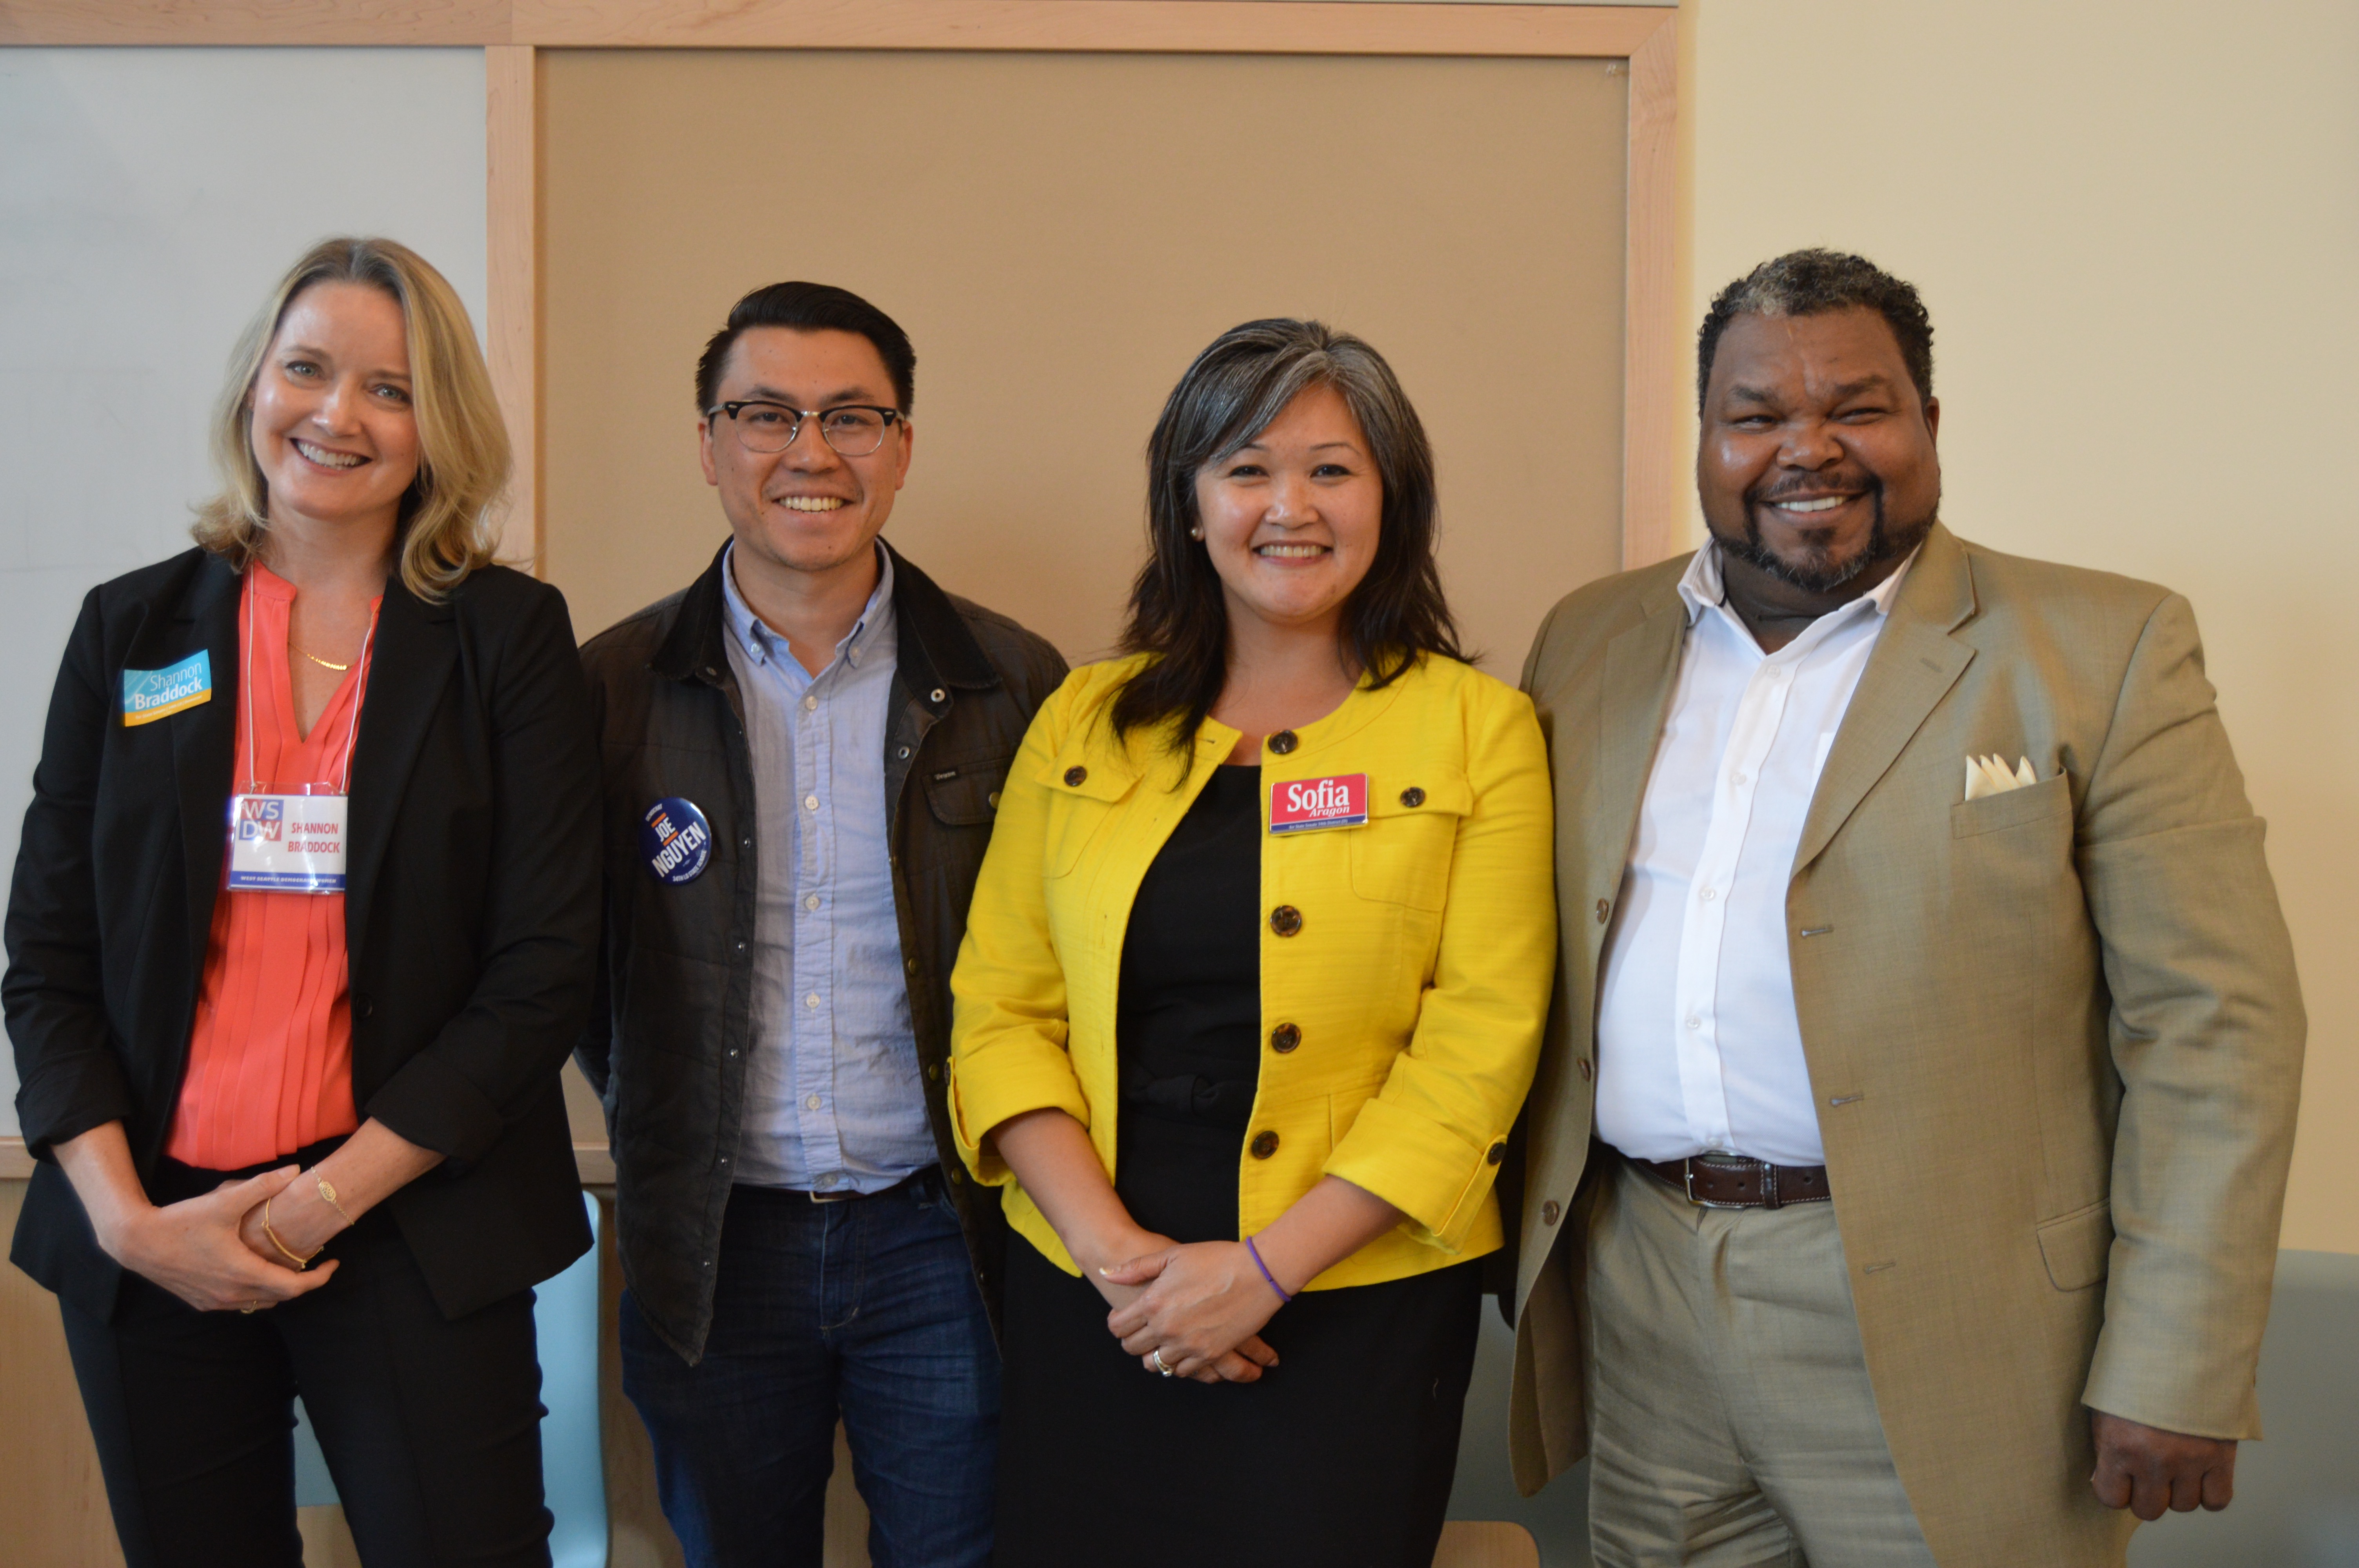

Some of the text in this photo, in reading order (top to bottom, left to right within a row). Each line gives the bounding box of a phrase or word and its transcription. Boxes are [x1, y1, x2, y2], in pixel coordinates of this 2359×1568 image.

[150, 662, 202, 691] Shannon
[135, 677, 202, 710] Braddock
[1287, 779, 1350, 812] Sofia
[242, 801, 279, 819] WS
[1309, 806, 1350, 817] Aragon
[243, 820, 280, 839] DW
[292, 822, 338, 834] SHANNON
[655, 817, 676, 842] JOE
[288, 841, 340, 853] BRADDOCK
[652, 821, 706, 878] NGUYEN
